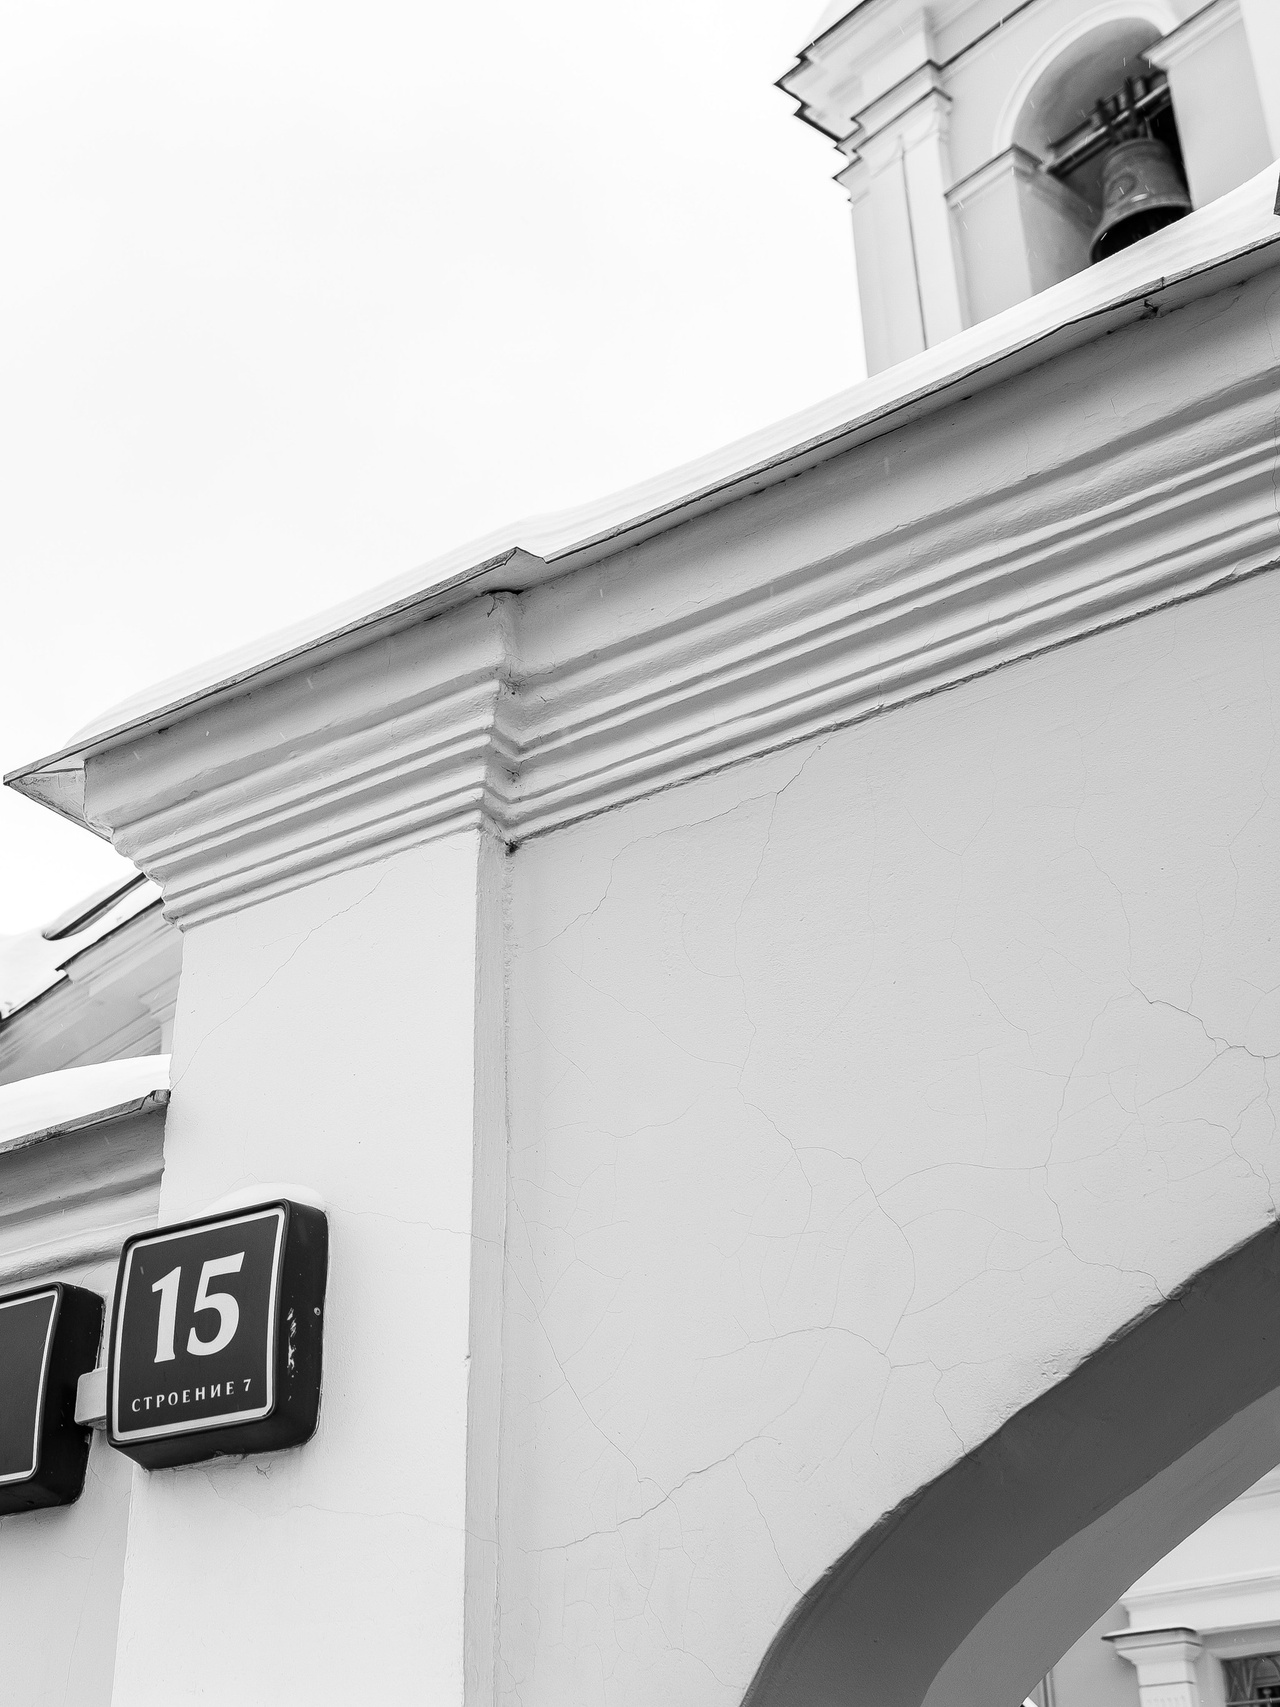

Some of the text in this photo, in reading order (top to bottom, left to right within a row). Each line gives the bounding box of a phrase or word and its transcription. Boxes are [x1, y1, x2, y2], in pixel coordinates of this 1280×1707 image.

[151, 1251, 246, 1364] 15
[131, 1378, 252, 1412] СТРОЕНИЕ 7
